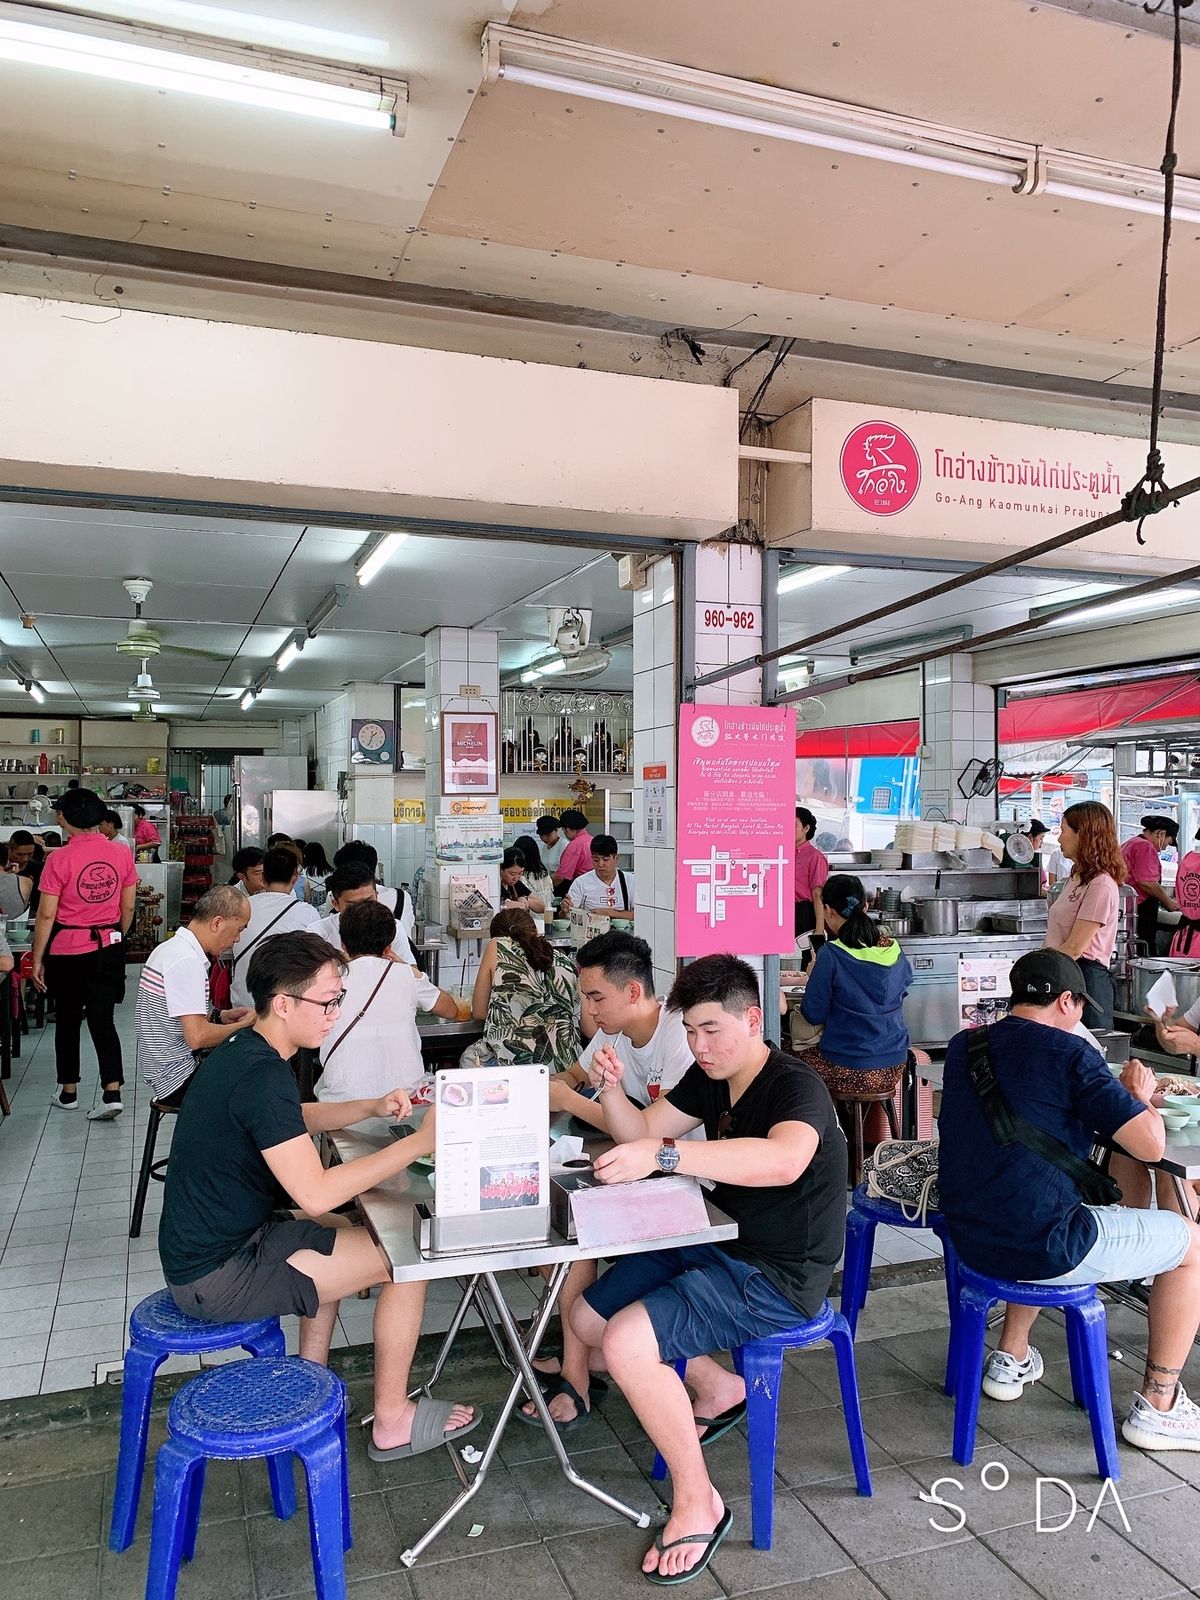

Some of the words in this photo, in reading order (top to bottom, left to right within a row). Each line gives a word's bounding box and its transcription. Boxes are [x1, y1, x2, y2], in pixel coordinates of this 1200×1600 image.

[935, 448, 1120, 500] โกอ่างข้าวมันไก่ประตูน้ำ
[935, 492, 982, 509] Go-Ang
[989, 498, 1058, 515] Kaomunkai
[1064, 505, 1109, 519] Pratun
[704, 609, 754, 629] 960-962
